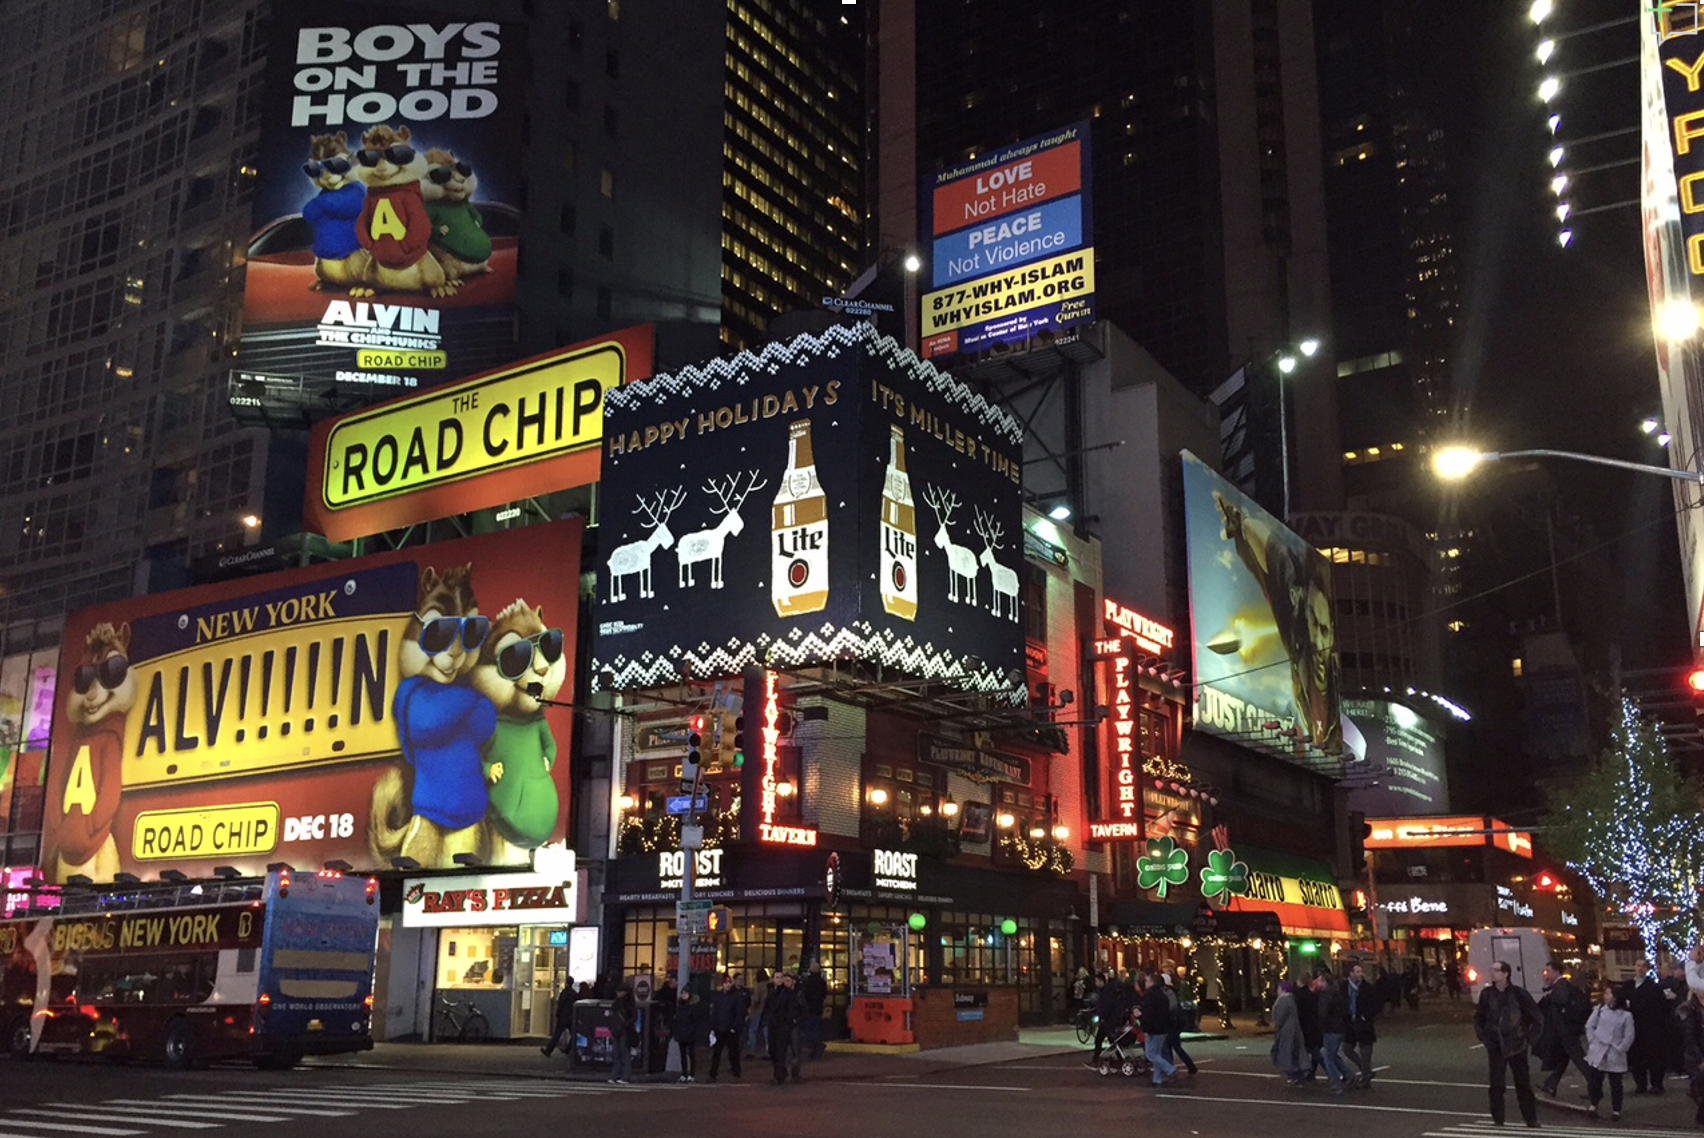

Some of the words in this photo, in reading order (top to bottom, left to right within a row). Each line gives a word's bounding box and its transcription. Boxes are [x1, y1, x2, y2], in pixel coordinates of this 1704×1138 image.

[295, 22, 501, 64] BOYS
[293, 65, 376, 91] ON
[397, 60, 498, 87] THE
[290, 88, 498, 127] HOOD
[936, 155, 998, 184] Muhammad
[1000, 142, 1038, 163] always
[1040, 128, 1077, 149] taught
[976, 161, 1032, 195] LOVE
[965, 195, 996, 220] Not
[1002, 182, 1046, 207] Hate
[370, 198, 406, 240] A
[968, 212, 1042, 249] PEACE
[948, 258, 980, 277] Not
[985, 231, 1065, 265] Violence
[933, 256, 1084, 311] 877-WHY-ISLAM
[320, 300, 440, 334] ALVIN
[932, 276, 1084, 329] WHYISLAM.ORG
[1061, 300, 1085, 311] Free
[1033, 317, 1049, 326] York
[319, 330, 350, 342] THE
[350, 333, 438, 350] CHIPMUNKS
[364, 355, 404, 366] ROAD
[408, 356, 442, 367] CHIP
[336, 371, 401, 386] DECEMBER
[404, 377, 418, 387] 18
[452, 391, 479, 415] THE
[609, 417, 689, 458] HAPPY
[698, 380, 841, 435] HOLIDAYS
[342, 418, 464, 495] ROAD
[483, 378, 602, 457] CHIP
[872, 379, 905, 418] IT'S
[910, 402, 976, 460] MILLER
[981, 445, 1020, 485] TIME
[777, 527, 823, 559] Lite
[885, 526, 915, 560] Lite
[196, 606, 260, 643] NEW
[265, 589, 338, 628] YORK
[1105, 599, 1173, 648] PLAYWRIGHT
[1095, 640, 1121, 654] THE
[1202, 684, 1245, 733] JUST
[1115, 657, 1135, 817] PLAYWRIGHT
[63, 745, 97, 815] A
[142, 824, 204, 854] ROAD
[213, 819, 268, 849] CHIP
[283, 814, 325, 842] DEC
[329, 813, 354, 838] 18
[760, 825, 817, 846] TAVERN
[1091, 824, 1137, 837] TAVERN
[874, 849, 918, 878] ROAST
[422, 889, 487, 913] RAY'S
[492, 884, 569, 911] PIZZA
[707, 890, 735, 898] LUNCHES
[744, 889, 777, 897] DELICIOUS
[777, 888, 805, 896] DINNERS
[881, 879, 910, 890] KITCHEN
[1299, 878, 1337, 909] sbarro
[1410, 896, 1448, 913] Bene
[120, 918, 164, 947] NEW
[169, 914, 221, 946] YORK
[272, 1003, 287, 1011] ONE
[289, 1003, 313, 1011] WORLD
[315, 1003, 361, 1011] OBSERVATORY
